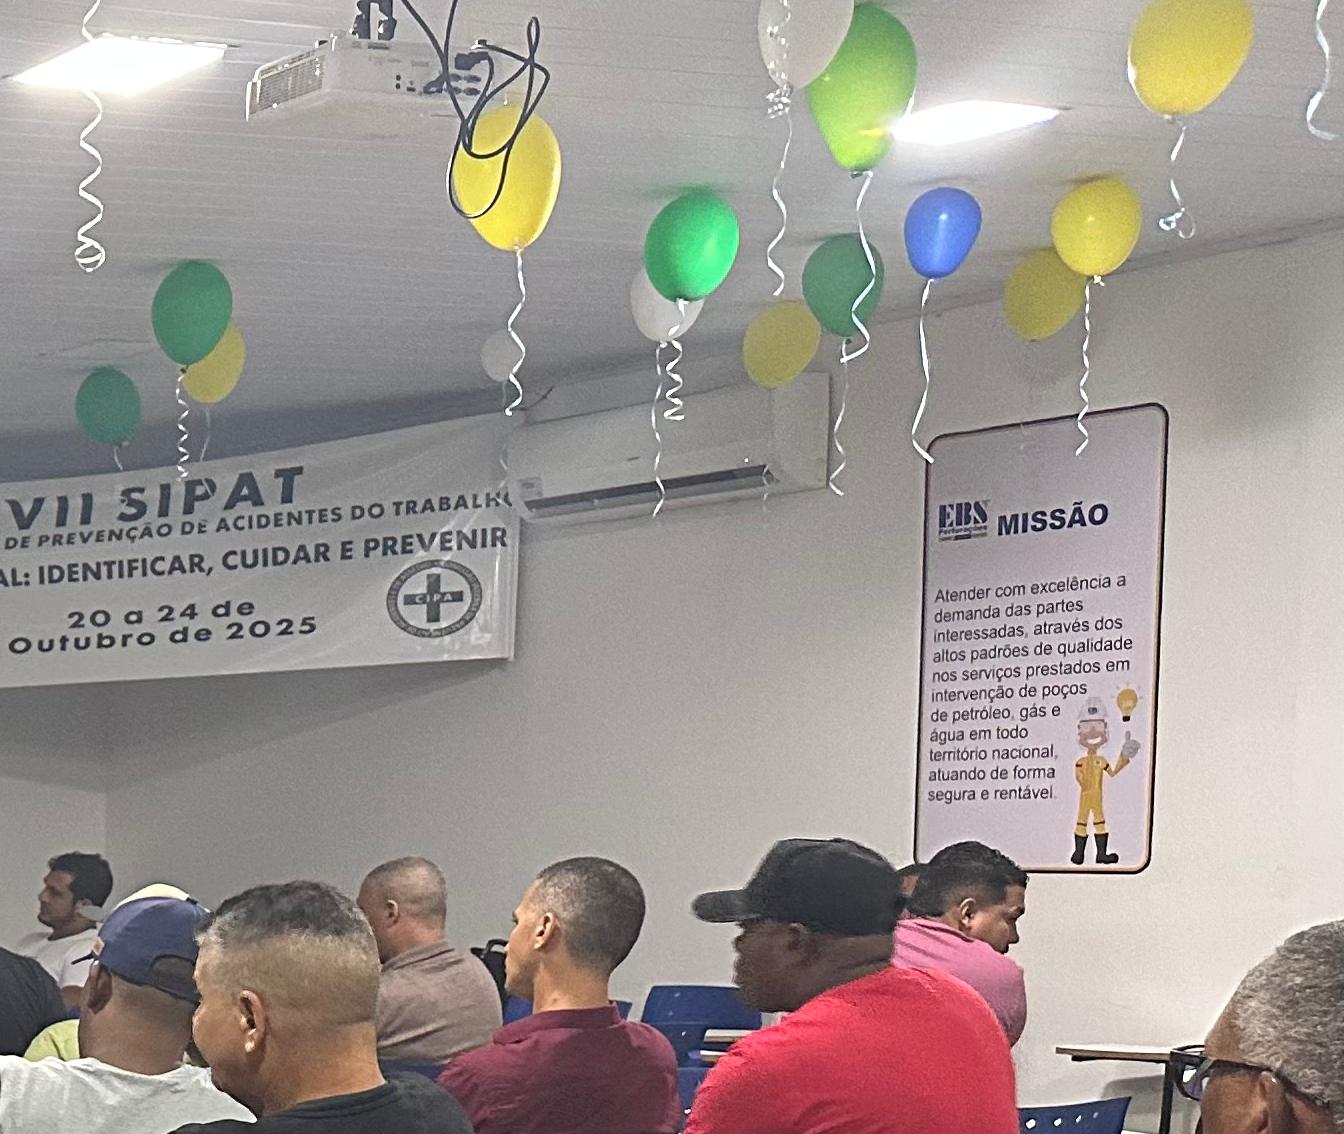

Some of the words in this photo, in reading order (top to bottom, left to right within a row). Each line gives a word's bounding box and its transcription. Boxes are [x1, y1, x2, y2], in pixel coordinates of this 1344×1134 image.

[5, 491, 94, 531] VII
[116, 465, 304, 524] SIPAT
[4, 536, 31, 551] DE
[37, 521, 172, 549] PREVENÇÃO
[180, 519, 208, 536] DE
[215, 506, 342, 534] ACIDENTES
[350, 502, 385, 521] DO
[938, 500, 988, 529] EBS
[997, 501, 1109, 537] MISSÃO
[37, 554, 214, 586] IDENTIFICAR,
[221, 541, 331, 572] CUIDAR
[340, 540, 354, 561] E
[363, 526, 508, 559] PREVENIR
[415, 592, 453, 603] CIPA
[934, 587, 991, 603] Atender
[994, 583, 1026, 598] com
[1030, 574, 1112, 595] excelência
[1115, 575, 1127, 588] a
[67, 608, 112, 630] 20
[123, 610, 144, 626] a
[157, 603, 199, 623] 24
[211, 599, 256, 618] de
[934, 606, 1001, 624] demanda
[1004, 603, 1032, 617] das
[1036, 599, 1084, 617] partes
[8, 632, 156, 655] Outubro
[168, 625, 213, 645] de
[225, 616, 317, 641] 2025
[933, 624, 1029, 643] interessadas,
[1033, 617, 1090, 636] através
[1094, 616, 1123, 631] dos
[932, 648, 966, 664] altos
[970, 644, 1029, 664] padrões
[1033, 641, 1053, 657] de
[1057, 636, 1133, 657] qualidade
[931, 670, 957, 683] nos
[961, 664, 1021, 682] serviços
[1025, 661, 1101, 680] prestados
[1105, 659, 1130, 672] em
[931, 685, 1014, 704] intervenção
[1018, 683, 1038, 699] de
[1041, 682, 1088, 700] poços
[930, 708, 948, 723] de
[951, 706, 1015, 725] petróleo,
[1019, 704, 1047, 722] gás
[1051, 705, 1061, 717] e
[929, 728, 964, 746] água
[968, 728, 992, 741] em
[996, 724, 1029, 740] todo
[929, 745, 988, 763] território
[991, 744, 1059, 761] nacional,
[928, 767, 986, 783] atuando
[989, 766, 1009, 781] de
[1013, 764, 1056, 780] forma
[927, 788, 976, 805] segura
[980, 787, 990, 801] e
